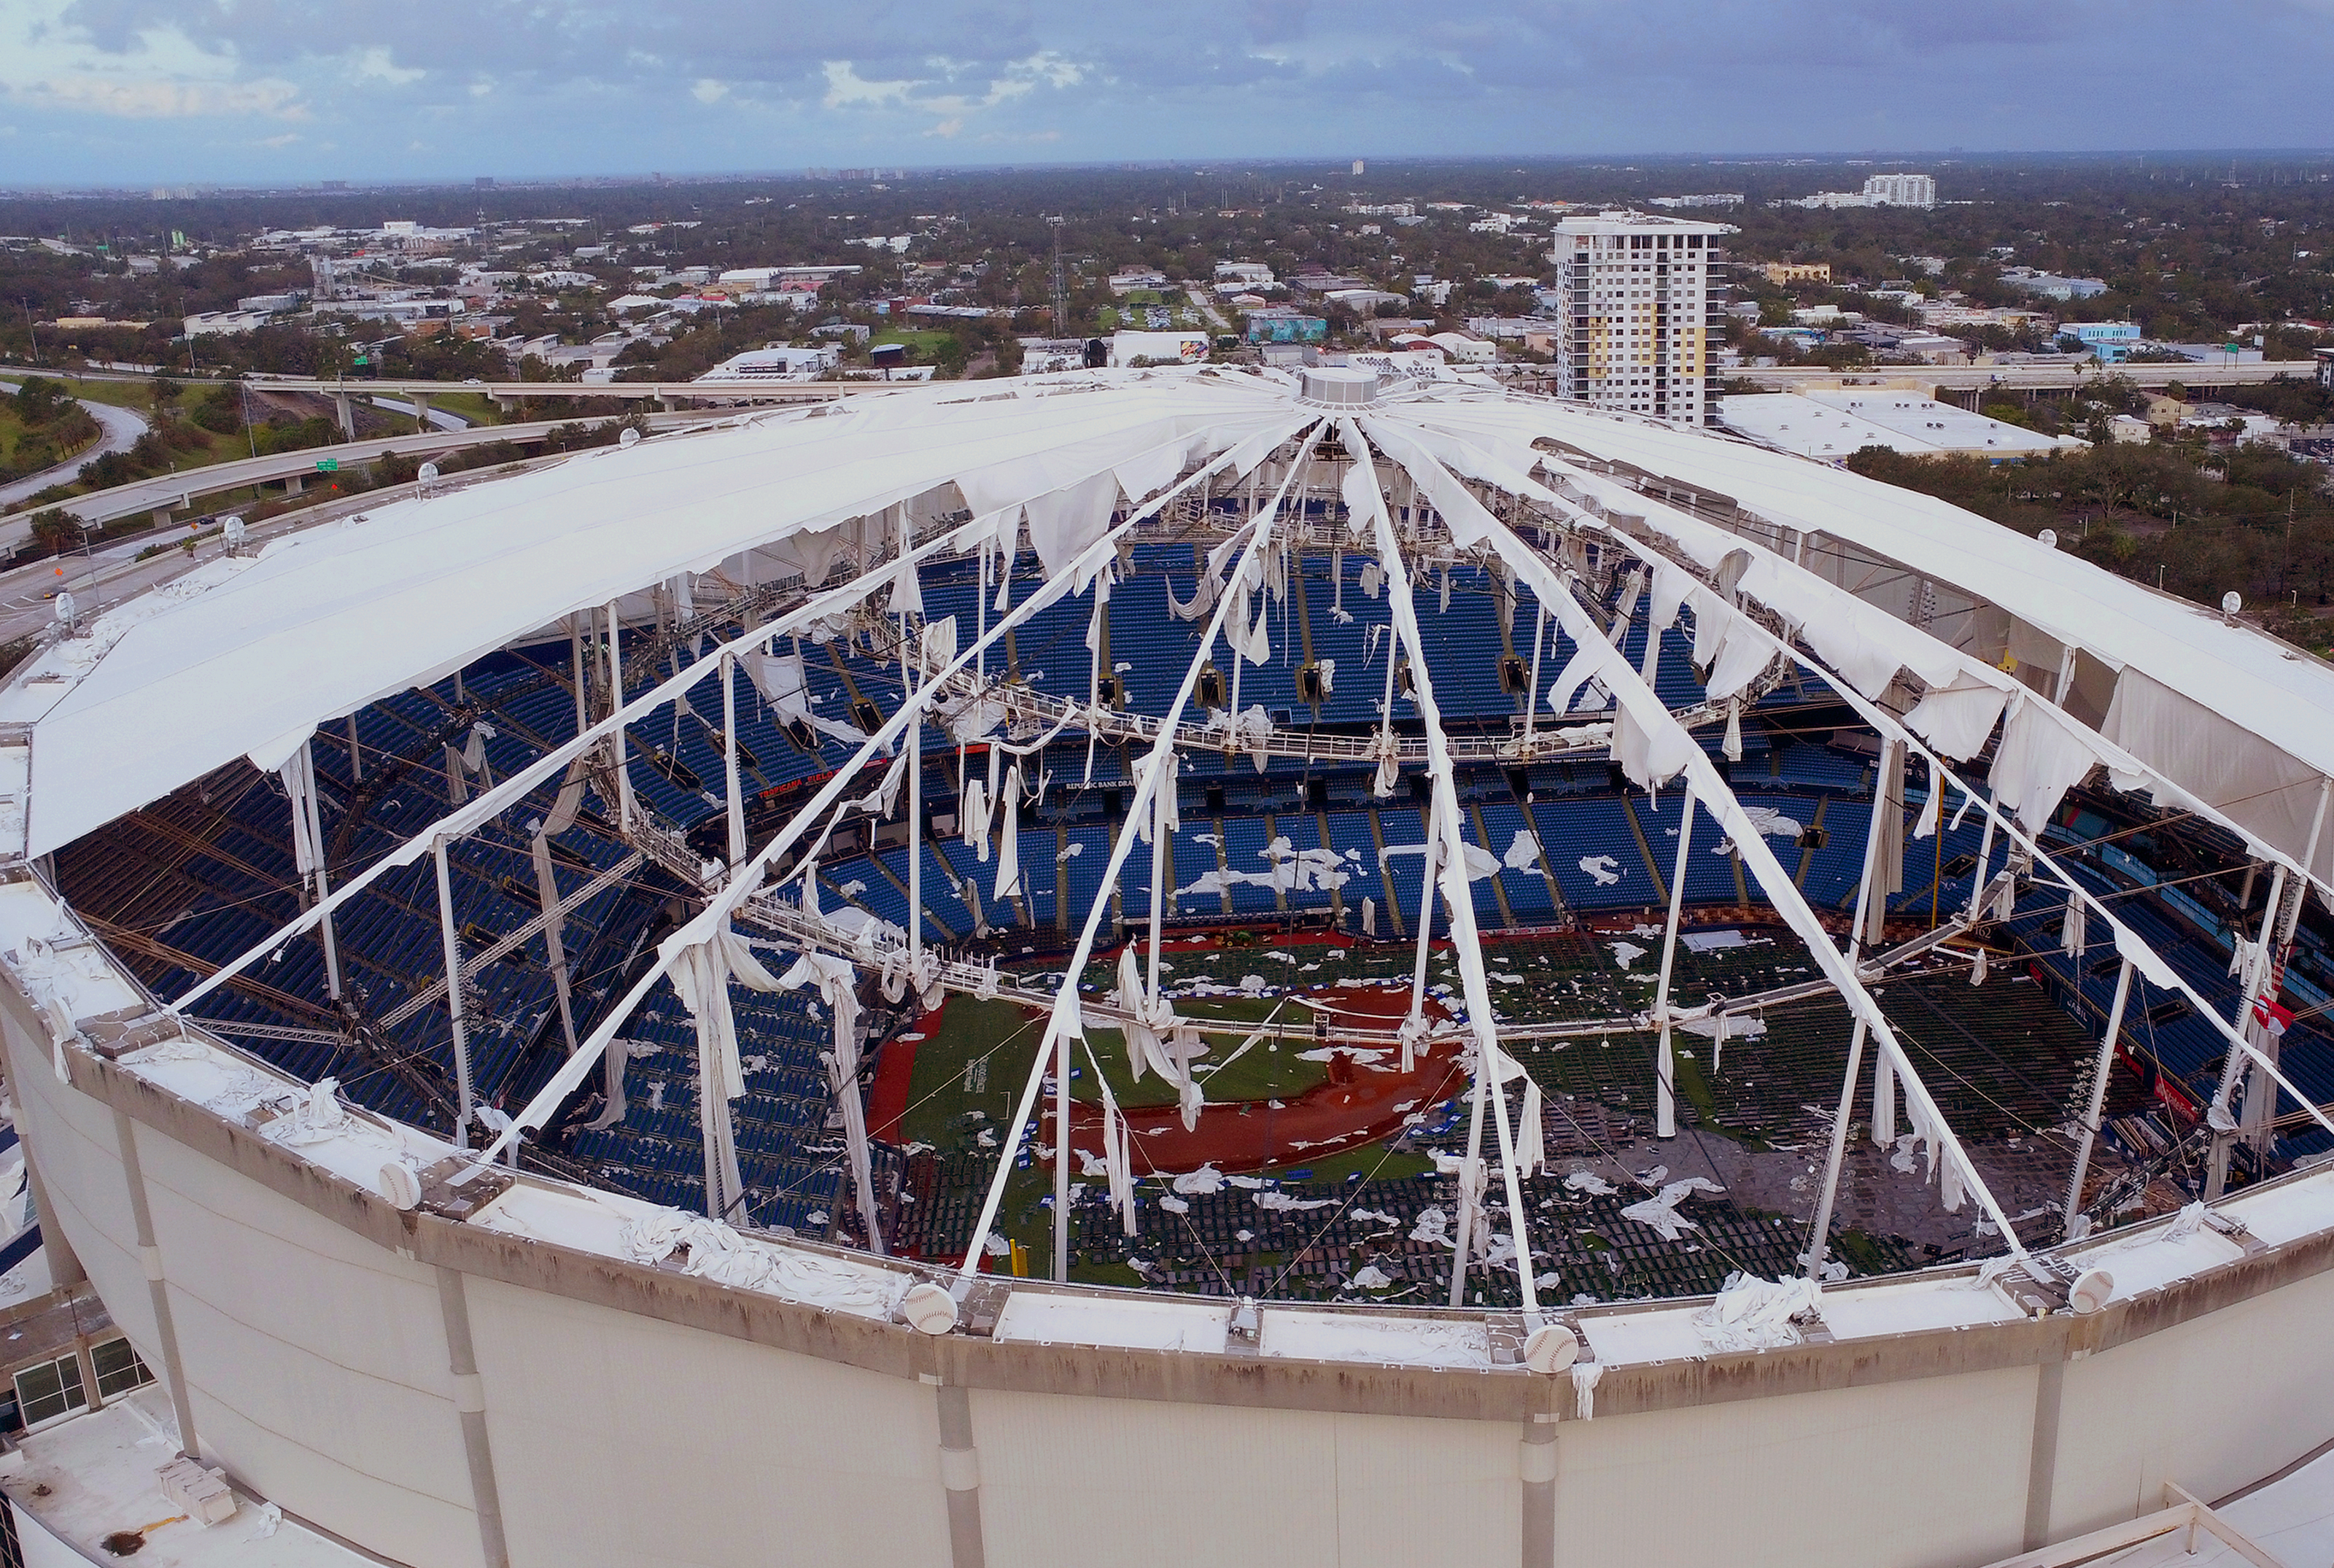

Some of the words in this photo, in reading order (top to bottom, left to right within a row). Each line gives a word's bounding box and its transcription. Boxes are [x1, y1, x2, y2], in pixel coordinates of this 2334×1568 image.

[758, 778, 802, 799] TROPICANA
[807, 771, 833, 783] FIELD
[1066, 781, 1098, 790] REPUIC
[1118, 779, 1136, 788] DRA
[1975, 925, 1992, 939] 162
[2066, 999, 2088, 1022] JABIL
